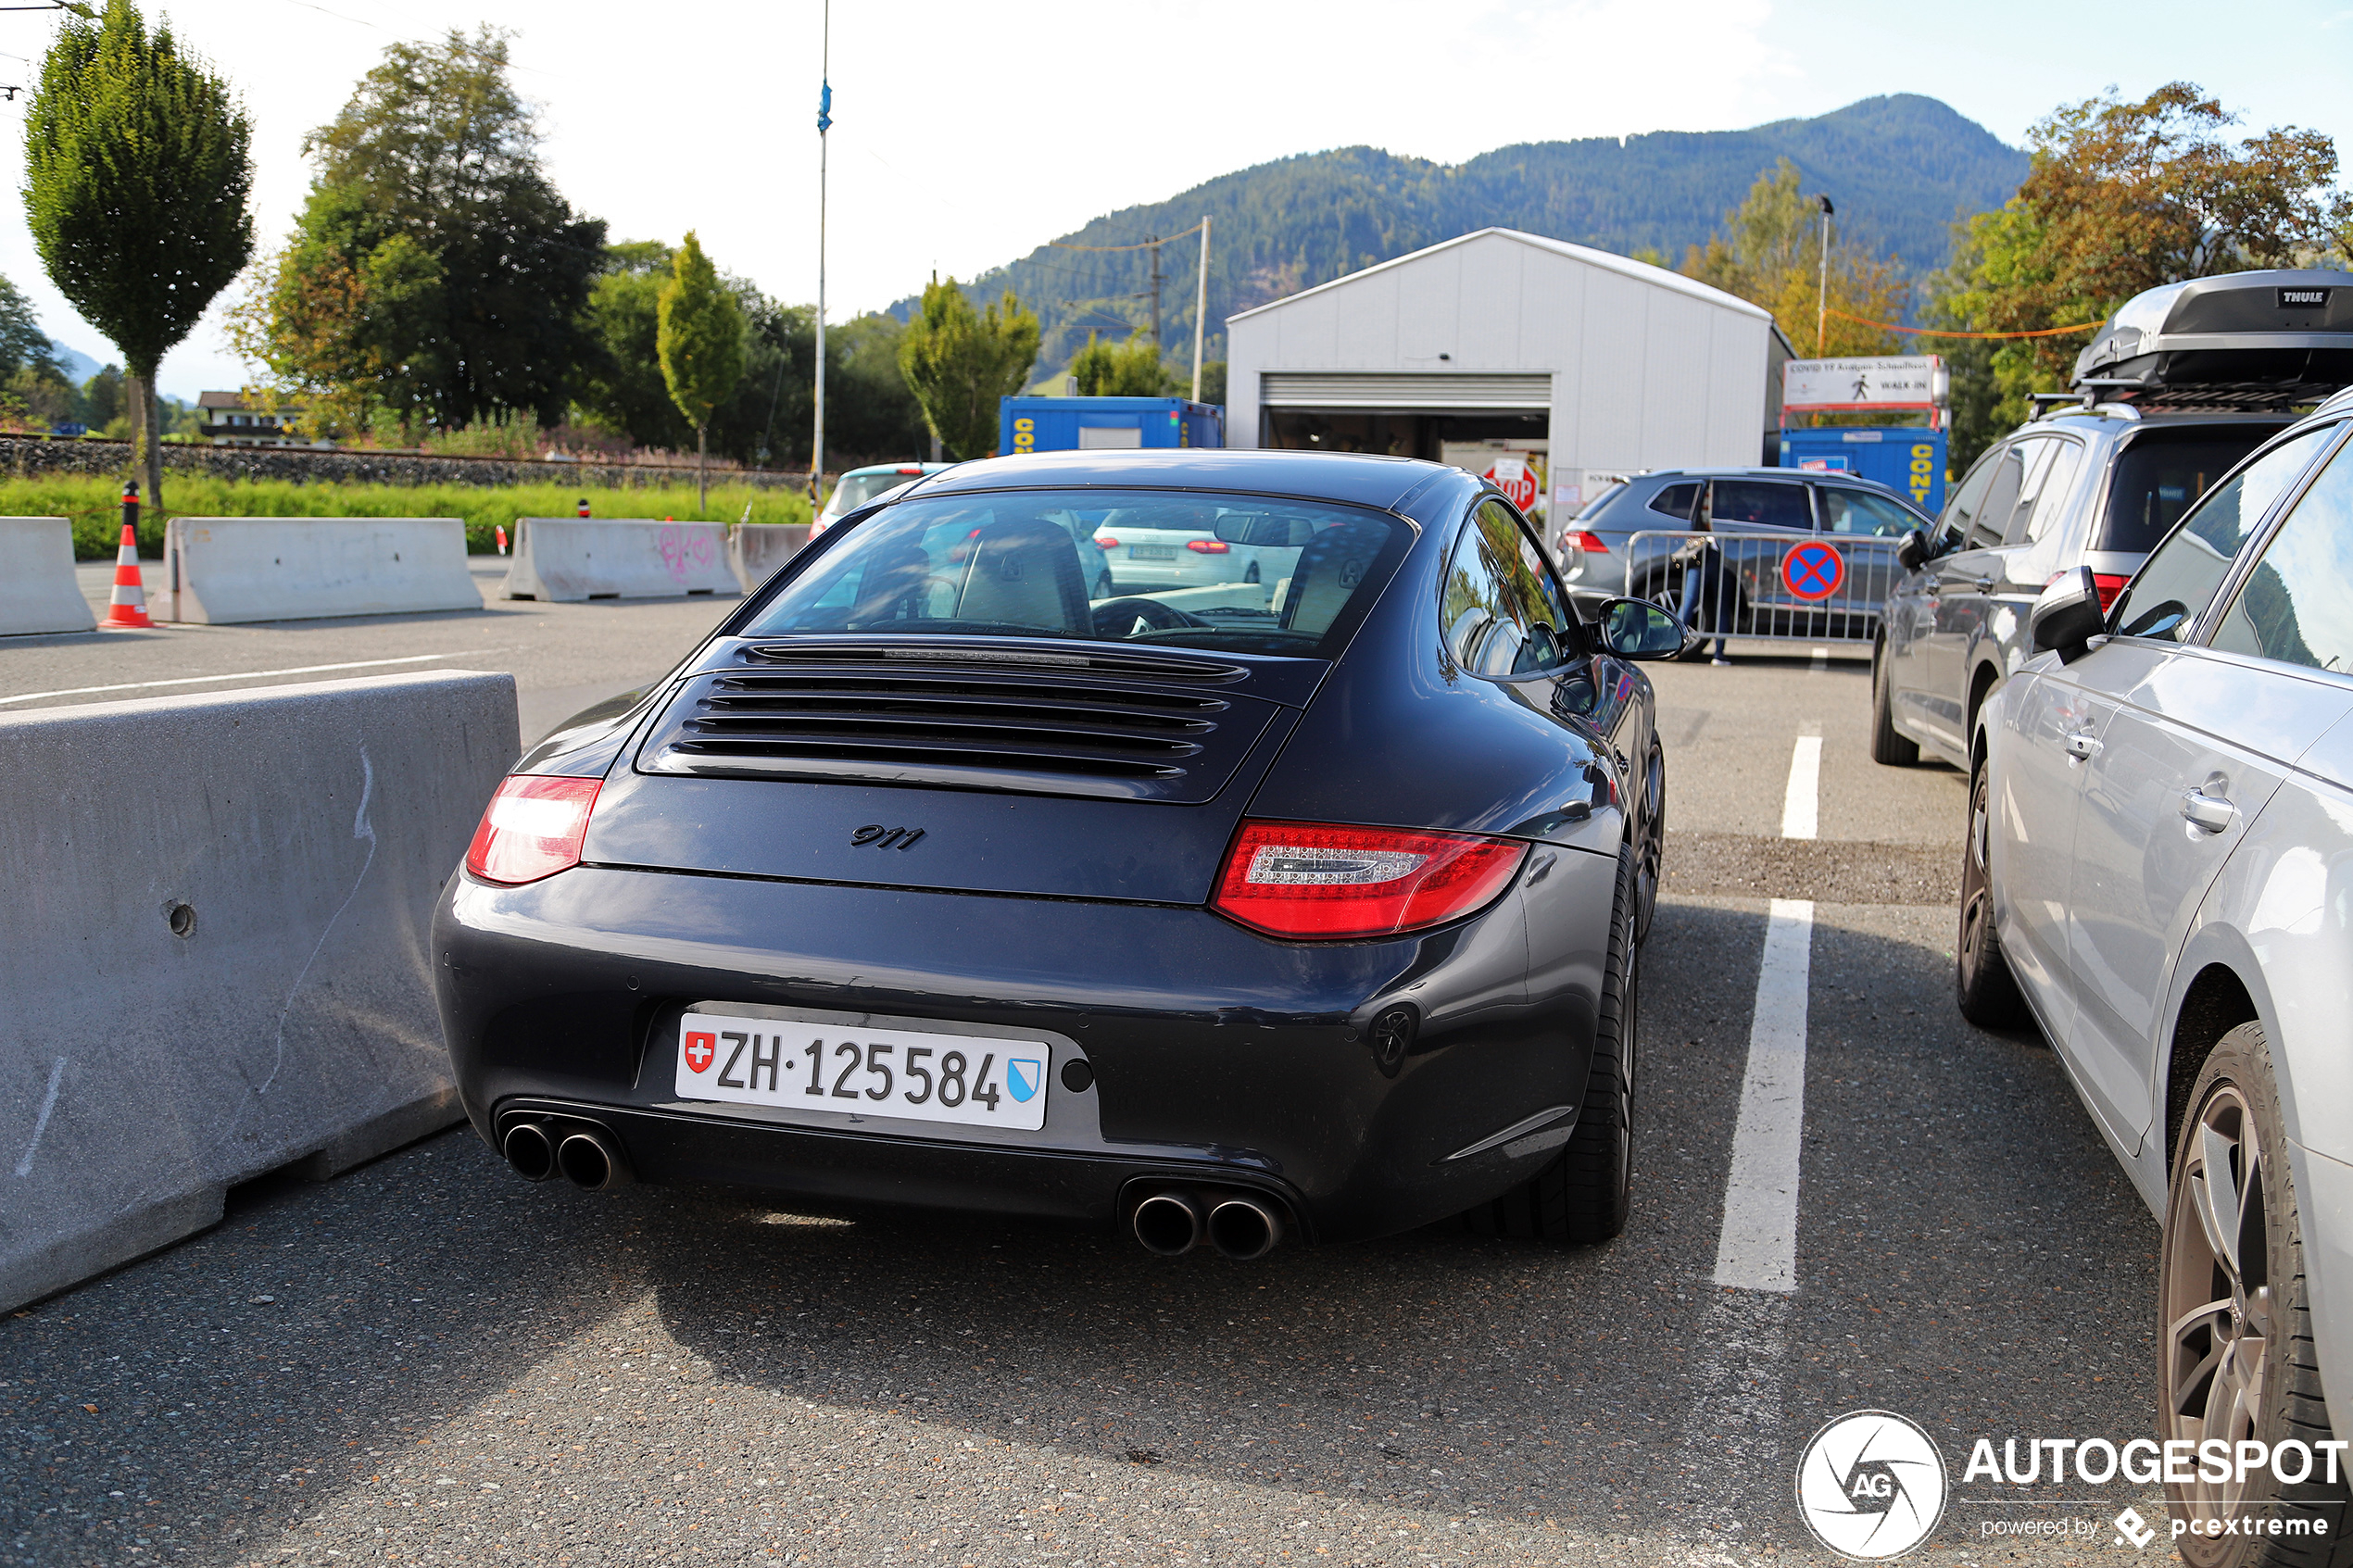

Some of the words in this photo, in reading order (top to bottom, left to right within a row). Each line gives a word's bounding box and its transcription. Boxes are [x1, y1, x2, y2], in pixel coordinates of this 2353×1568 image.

[2284, 292, 2323, 303] THULE
[1790, 363, 1822, 373] COVID
[1489, 478, 1533, 502] TOP
[849, 823, 925, 850] 911
